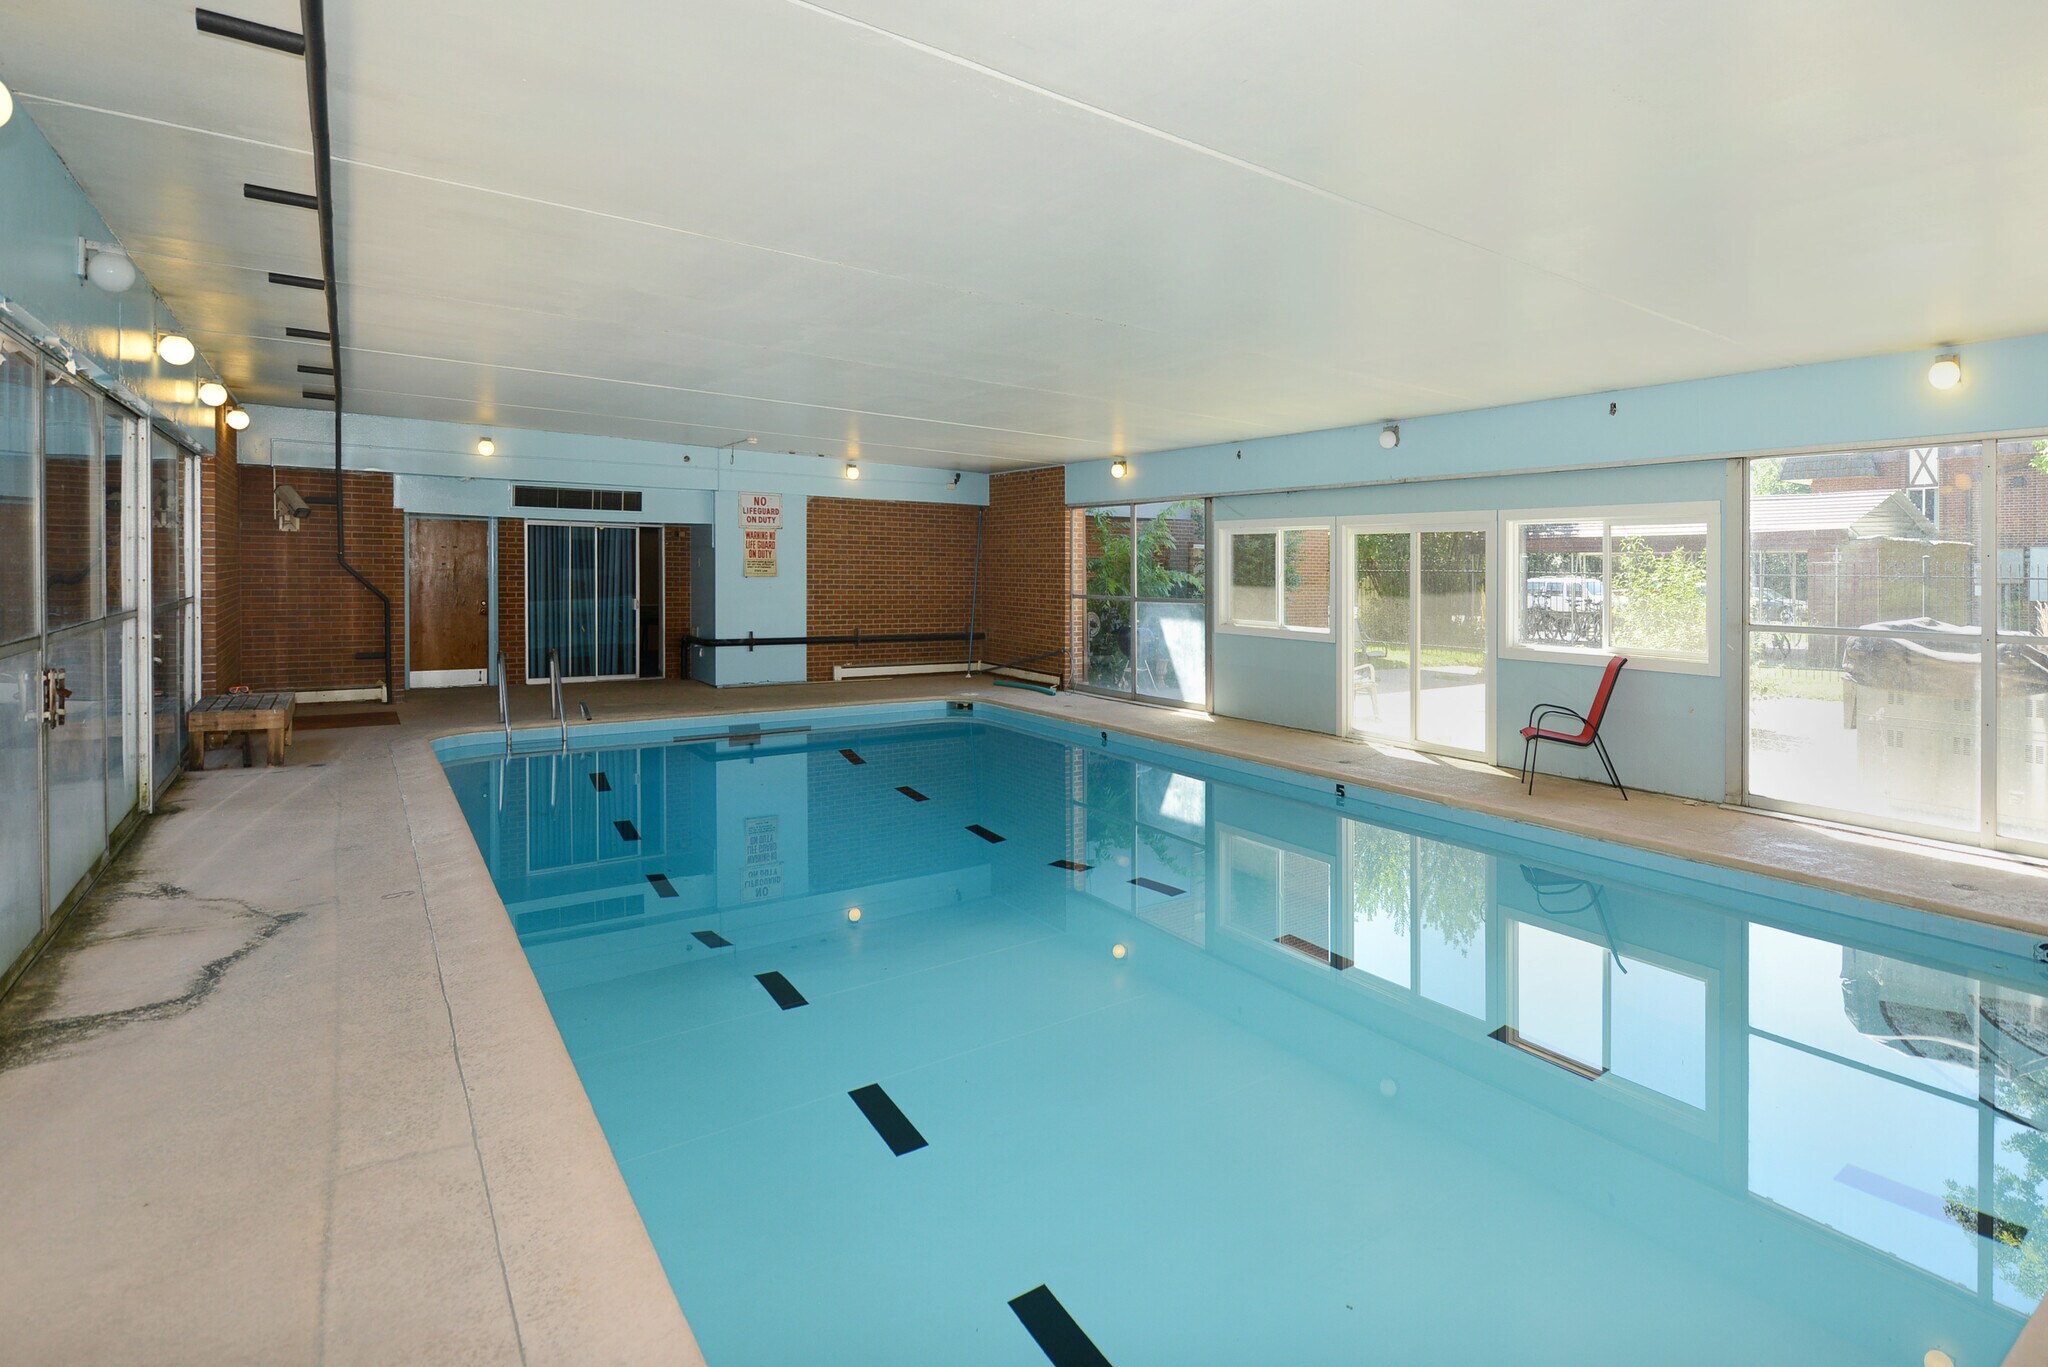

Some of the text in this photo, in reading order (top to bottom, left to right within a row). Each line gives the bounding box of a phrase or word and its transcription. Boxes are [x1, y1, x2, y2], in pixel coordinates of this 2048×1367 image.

[753, 496, 767, 506] NO
[742, 507, 780, 515] LIFEGUARD
[745, 531, 776, 540] WARNING NO
[745, 540, 776, 549] LIFE GUARD
[748, 549, 773, 559] ON DUTY
[1335, 783, 1345, 797] 5
